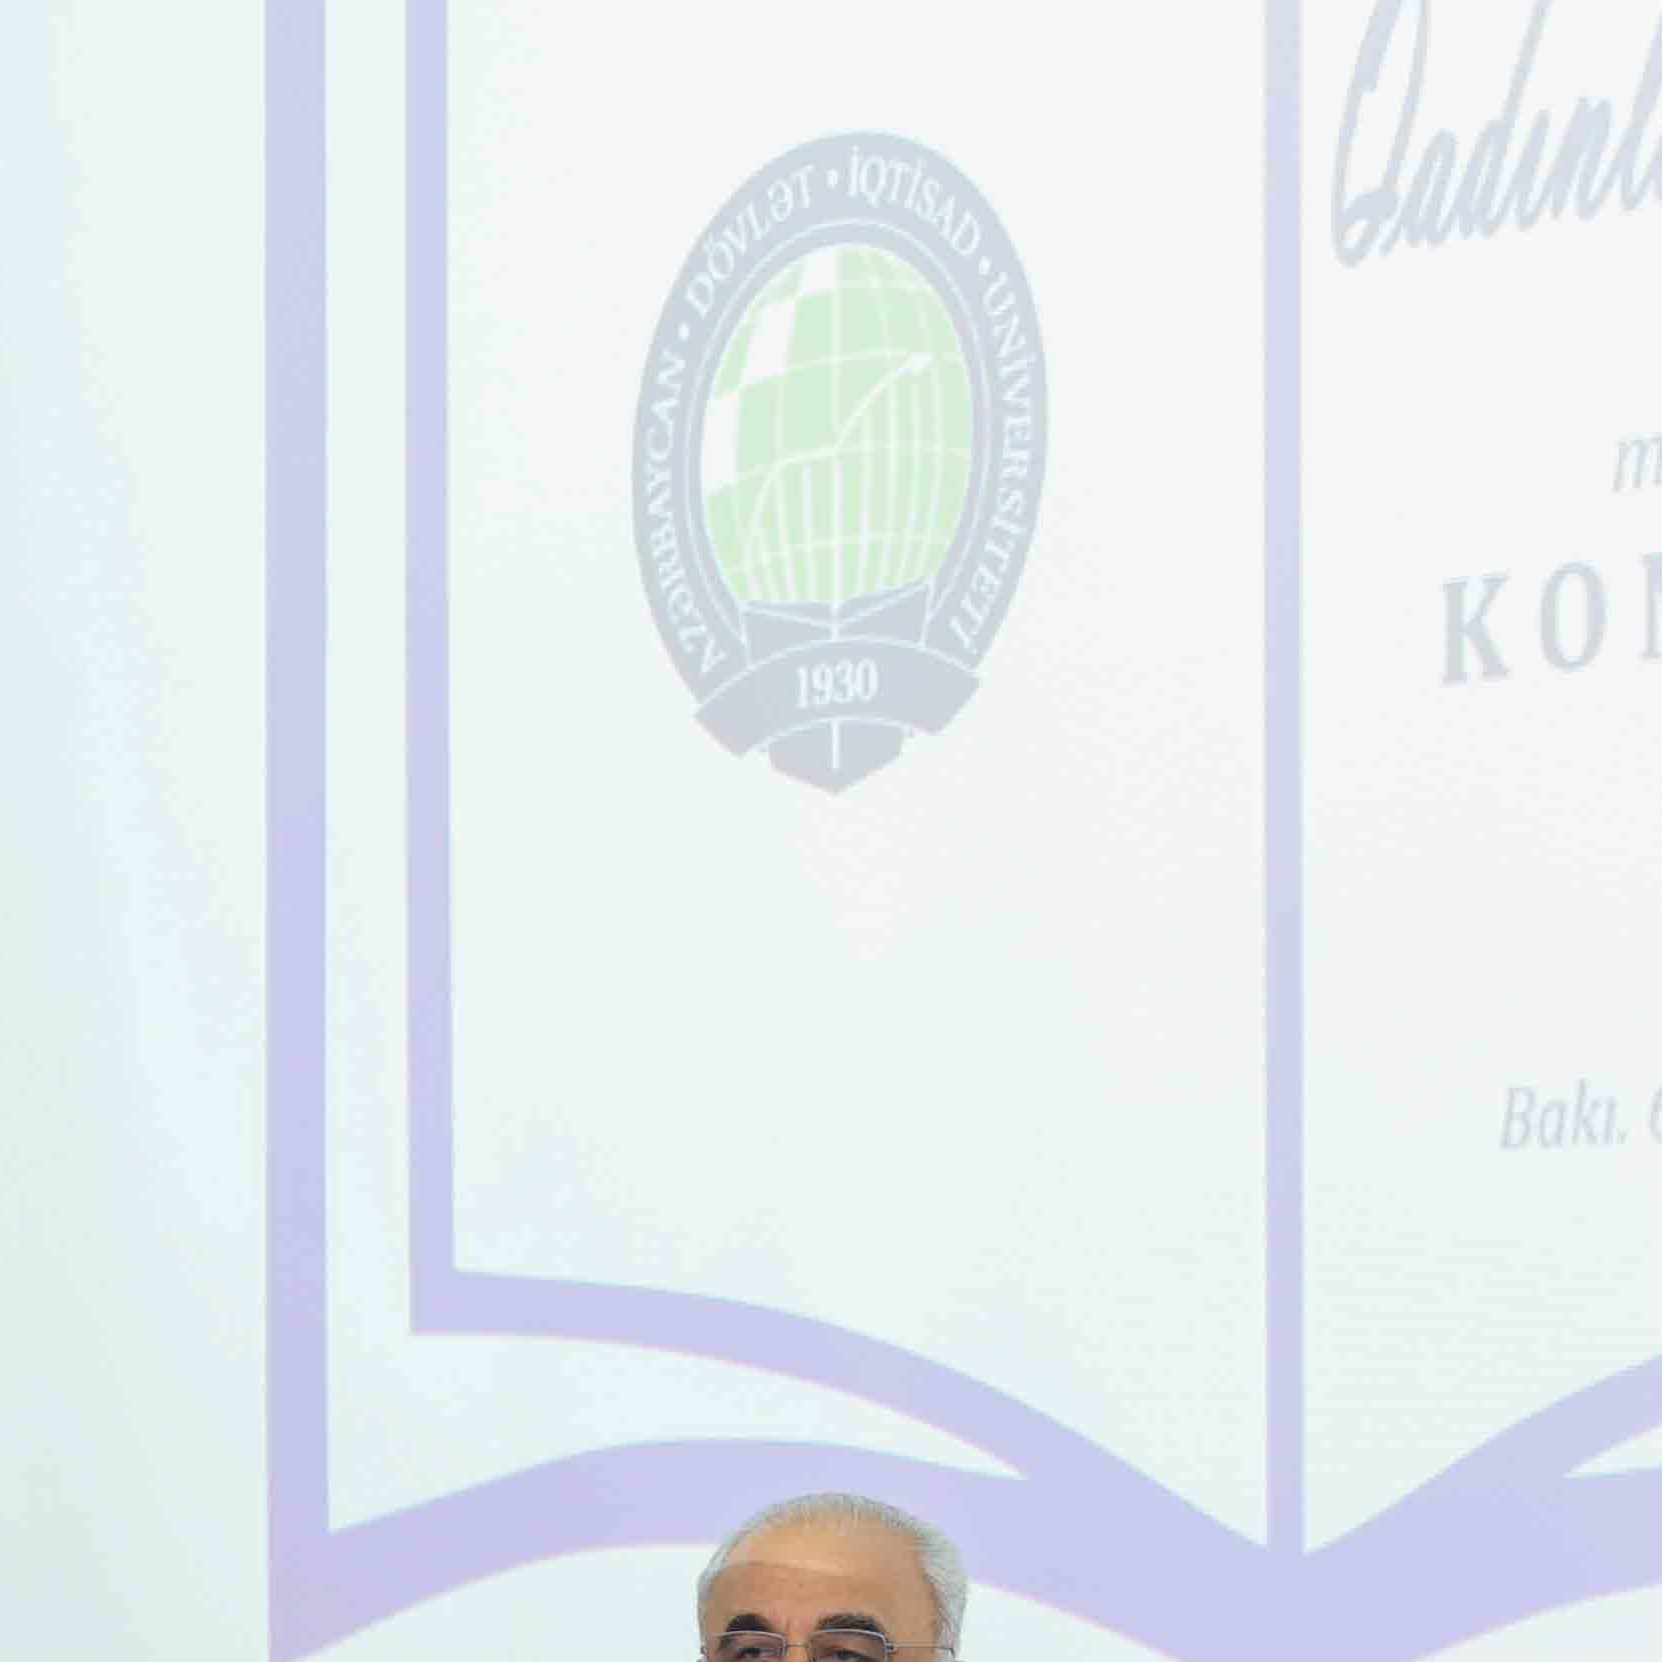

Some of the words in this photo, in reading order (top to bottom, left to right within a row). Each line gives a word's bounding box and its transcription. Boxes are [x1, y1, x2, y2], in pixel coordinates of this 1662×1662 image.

[685, 163, 816, 318] DÖVLƏT
[847, 145, 982, 259] İQTİSAD
[795, 656, 880, 710] 1930
